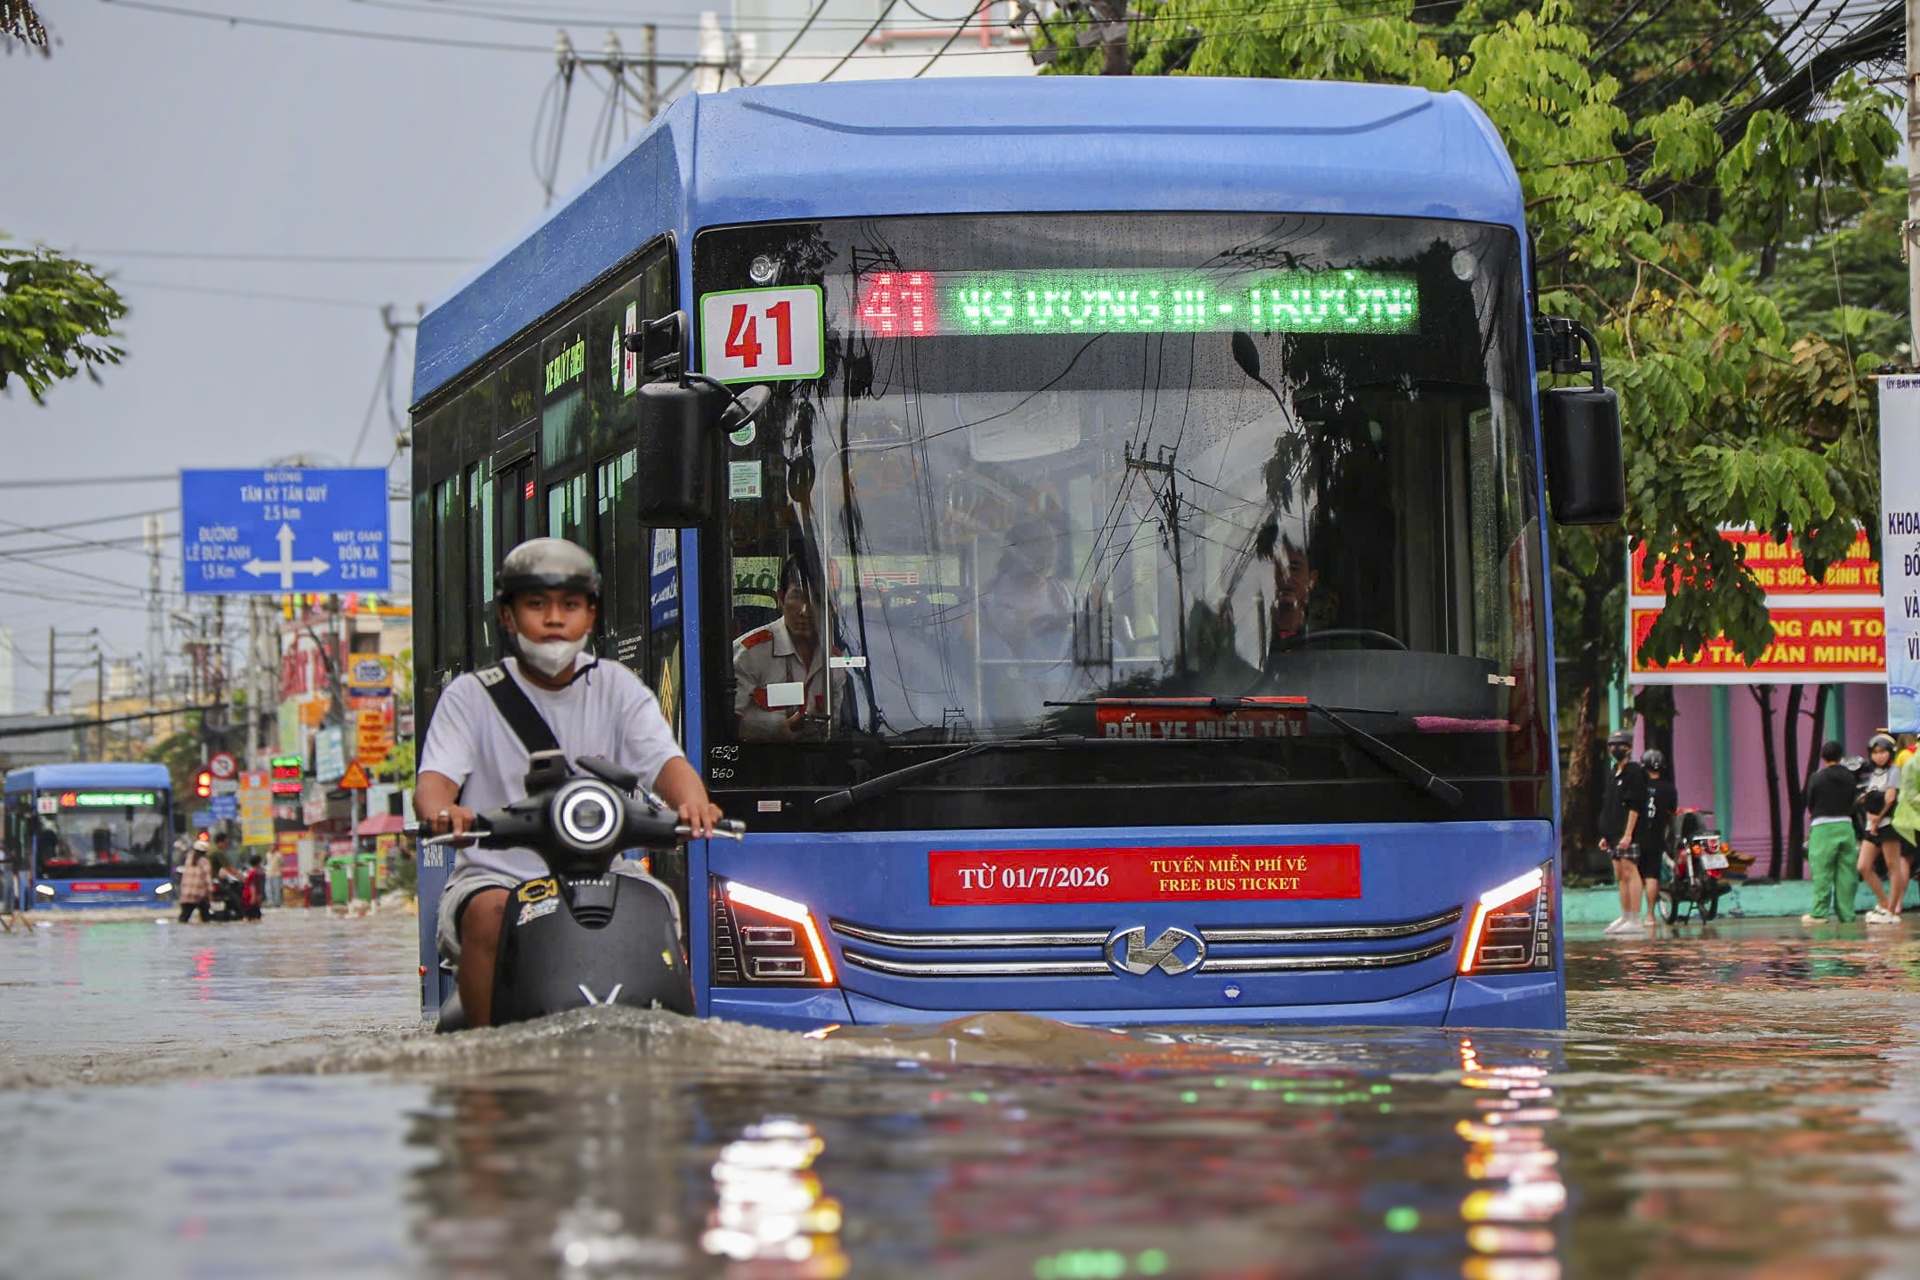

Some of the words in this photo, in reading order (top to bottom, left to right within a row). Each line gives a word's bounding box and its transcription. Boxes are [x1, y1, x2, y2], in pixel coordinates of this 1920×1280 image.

[864, 274, 924, 331] 41
[725, 301, 792, 368] 41
[240, 484, 262, 502] TÂN
[264, 505, 280, 521] 2.5
[282, 505, 300, 520] km
[199, 524, 238, 543] ĐƯỜNG
[1905, 541, 1920, 577] ĐỔ
[1809, 620, 1841, 637] AN
[1850, 620, 1884, 637] TO
[1814, 646, 1885, 666] MINH,
[1150, 855, 1207, 874] TUYẾN
[1209, 853, 1250, 873] MIỄN
[1254, 854, 1283, 873] PHÍ
[1286, 855, 1307, 872] VÉ
[958, 863, 996, 890] TỪ
[1001, 866, 1110, 890] 01/7/2026
[1159, 878, 1202, 892] FREE
[1205, 878, 1236, 892] BUS
[1238, 877, 1300, 891] TICKET
